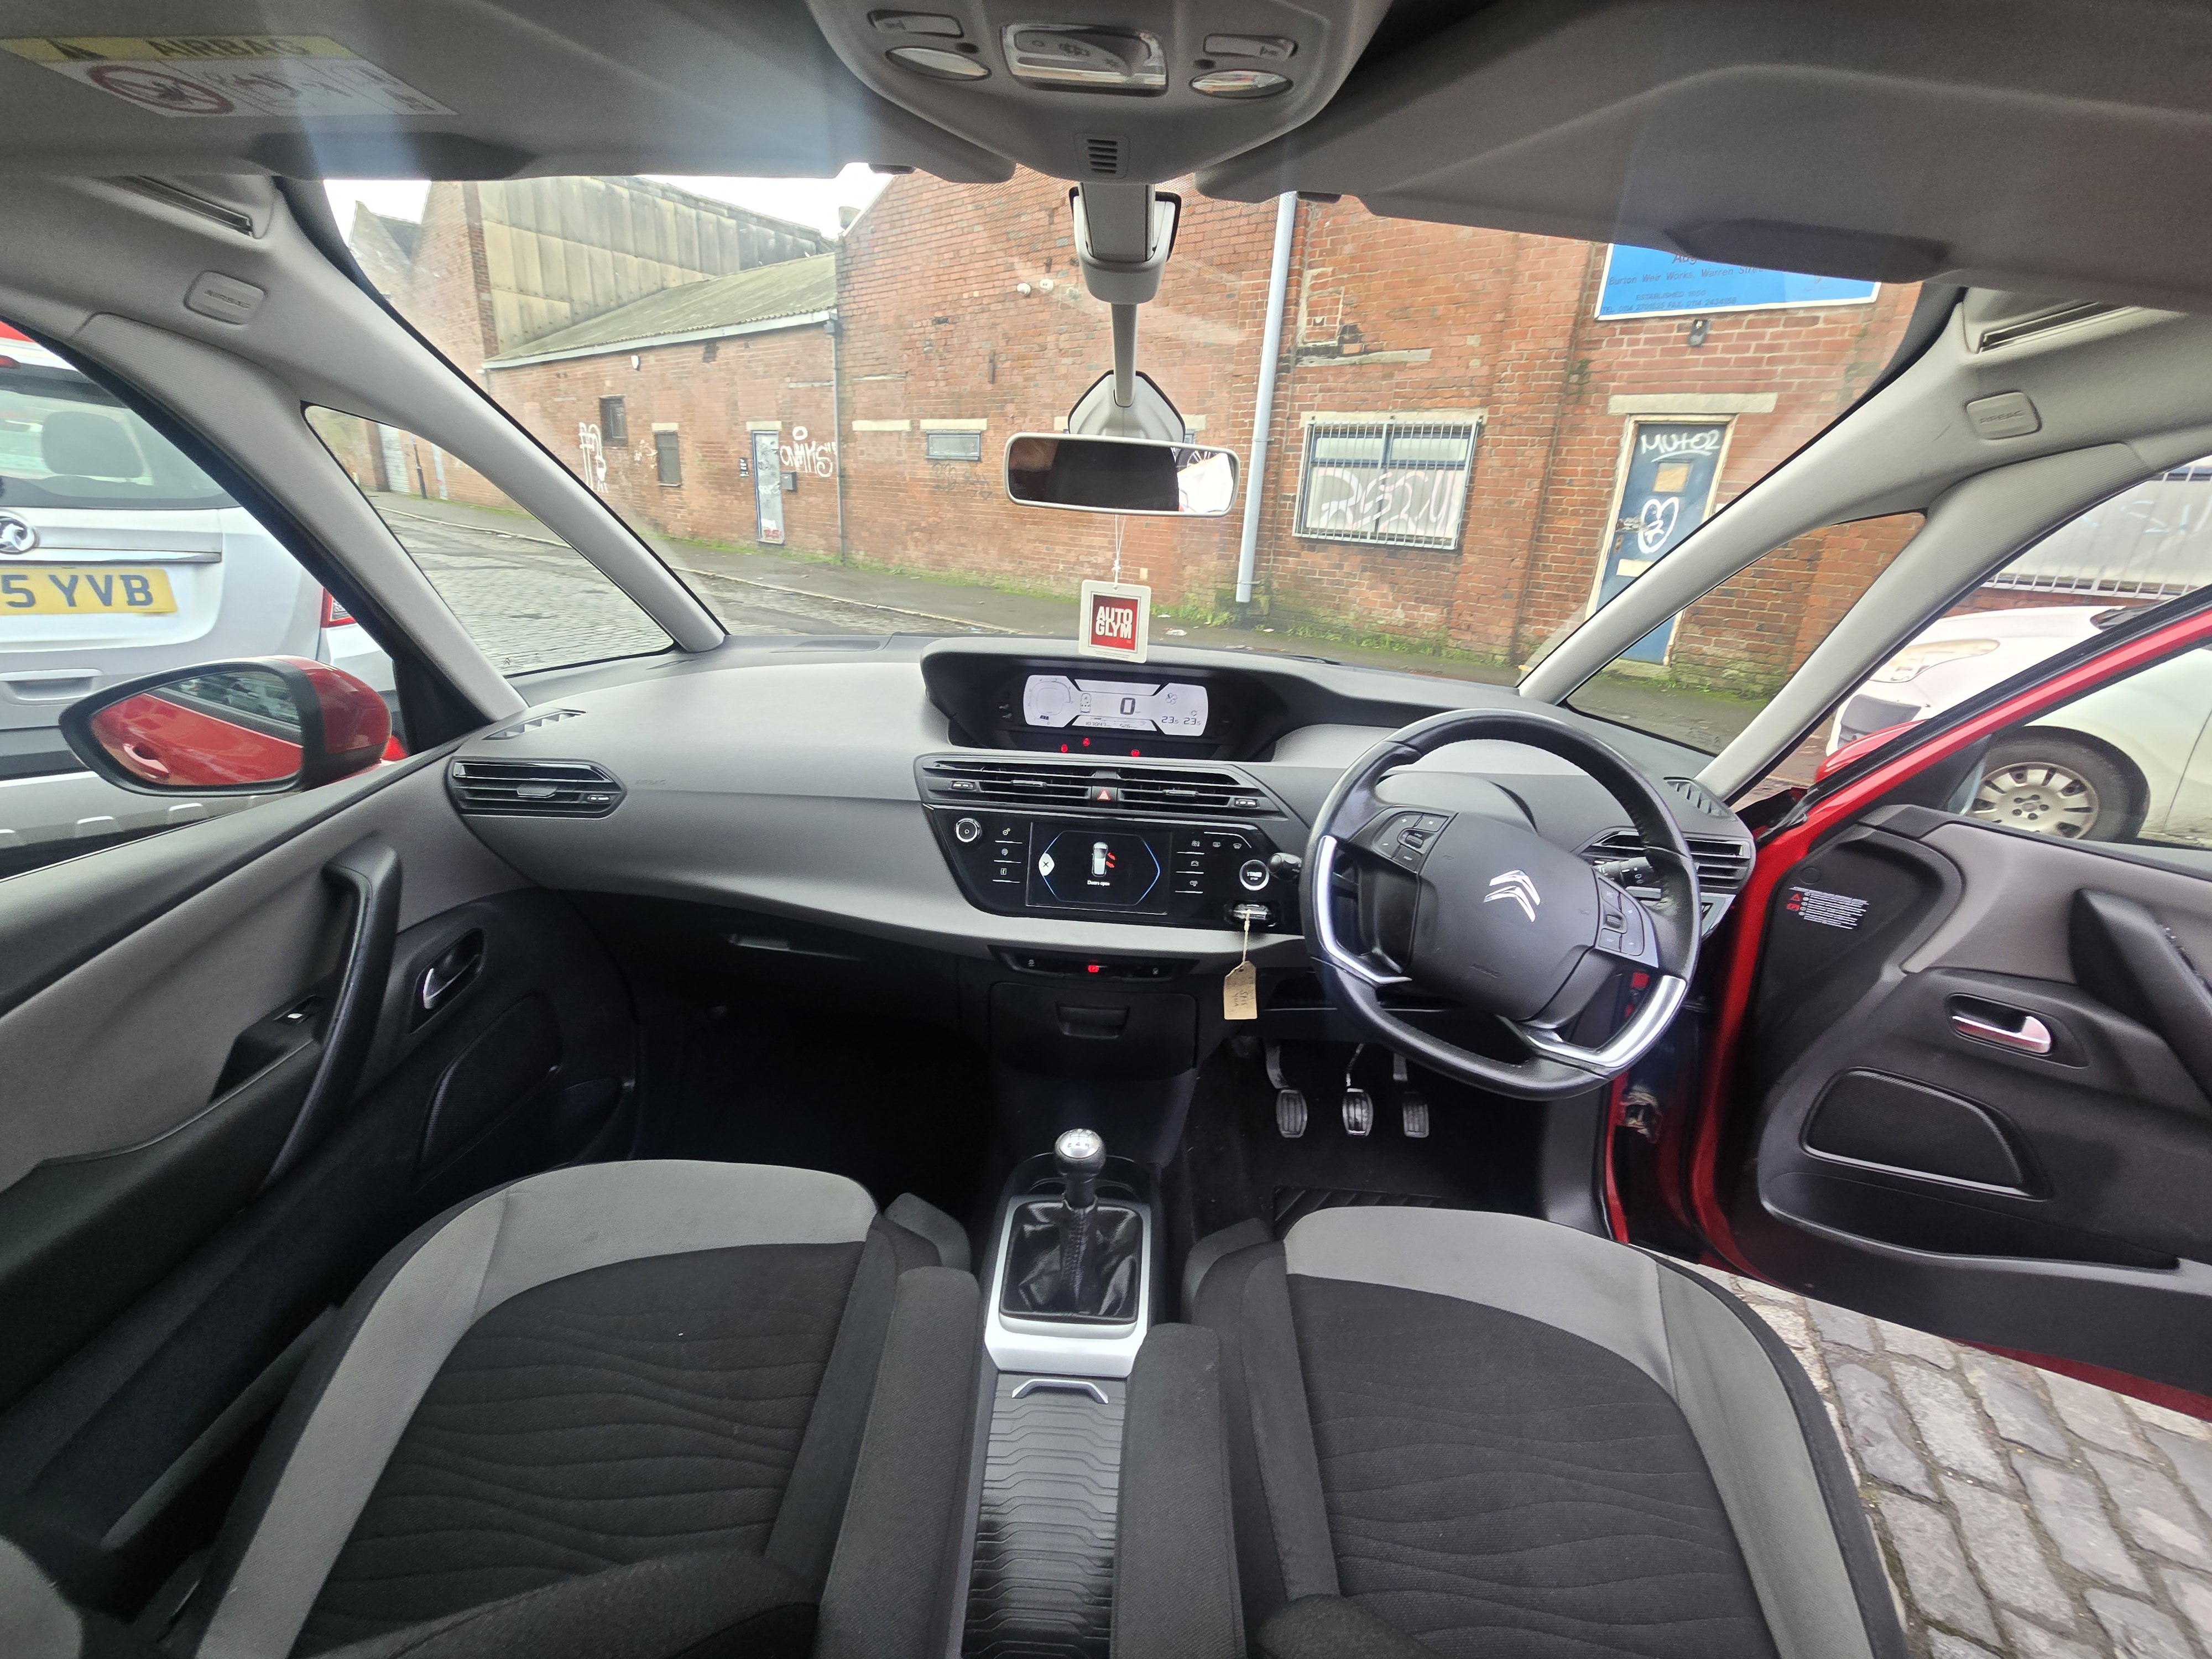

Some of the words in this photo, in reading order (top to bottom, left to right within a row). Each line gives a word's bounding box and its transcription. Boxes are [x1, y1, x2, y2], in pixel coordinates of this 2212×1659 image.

[148, 38, 311, 57] AIRBAG
[1608, 276, 1637, 285] Burton
[1642, 274, 1661, 283] Weir
[1701, 268, 1733, 277] Warren
[1636, 291, 1684, 301] ESTABLISHED
[1, 575, 36, 608] 5
[48, 574, 154, 607] YVB
[1096, 606, 1133, 625] AUTO
[1095, 620, 1132, 639] GLYM
[1120, 697, 1136, 715] 0
